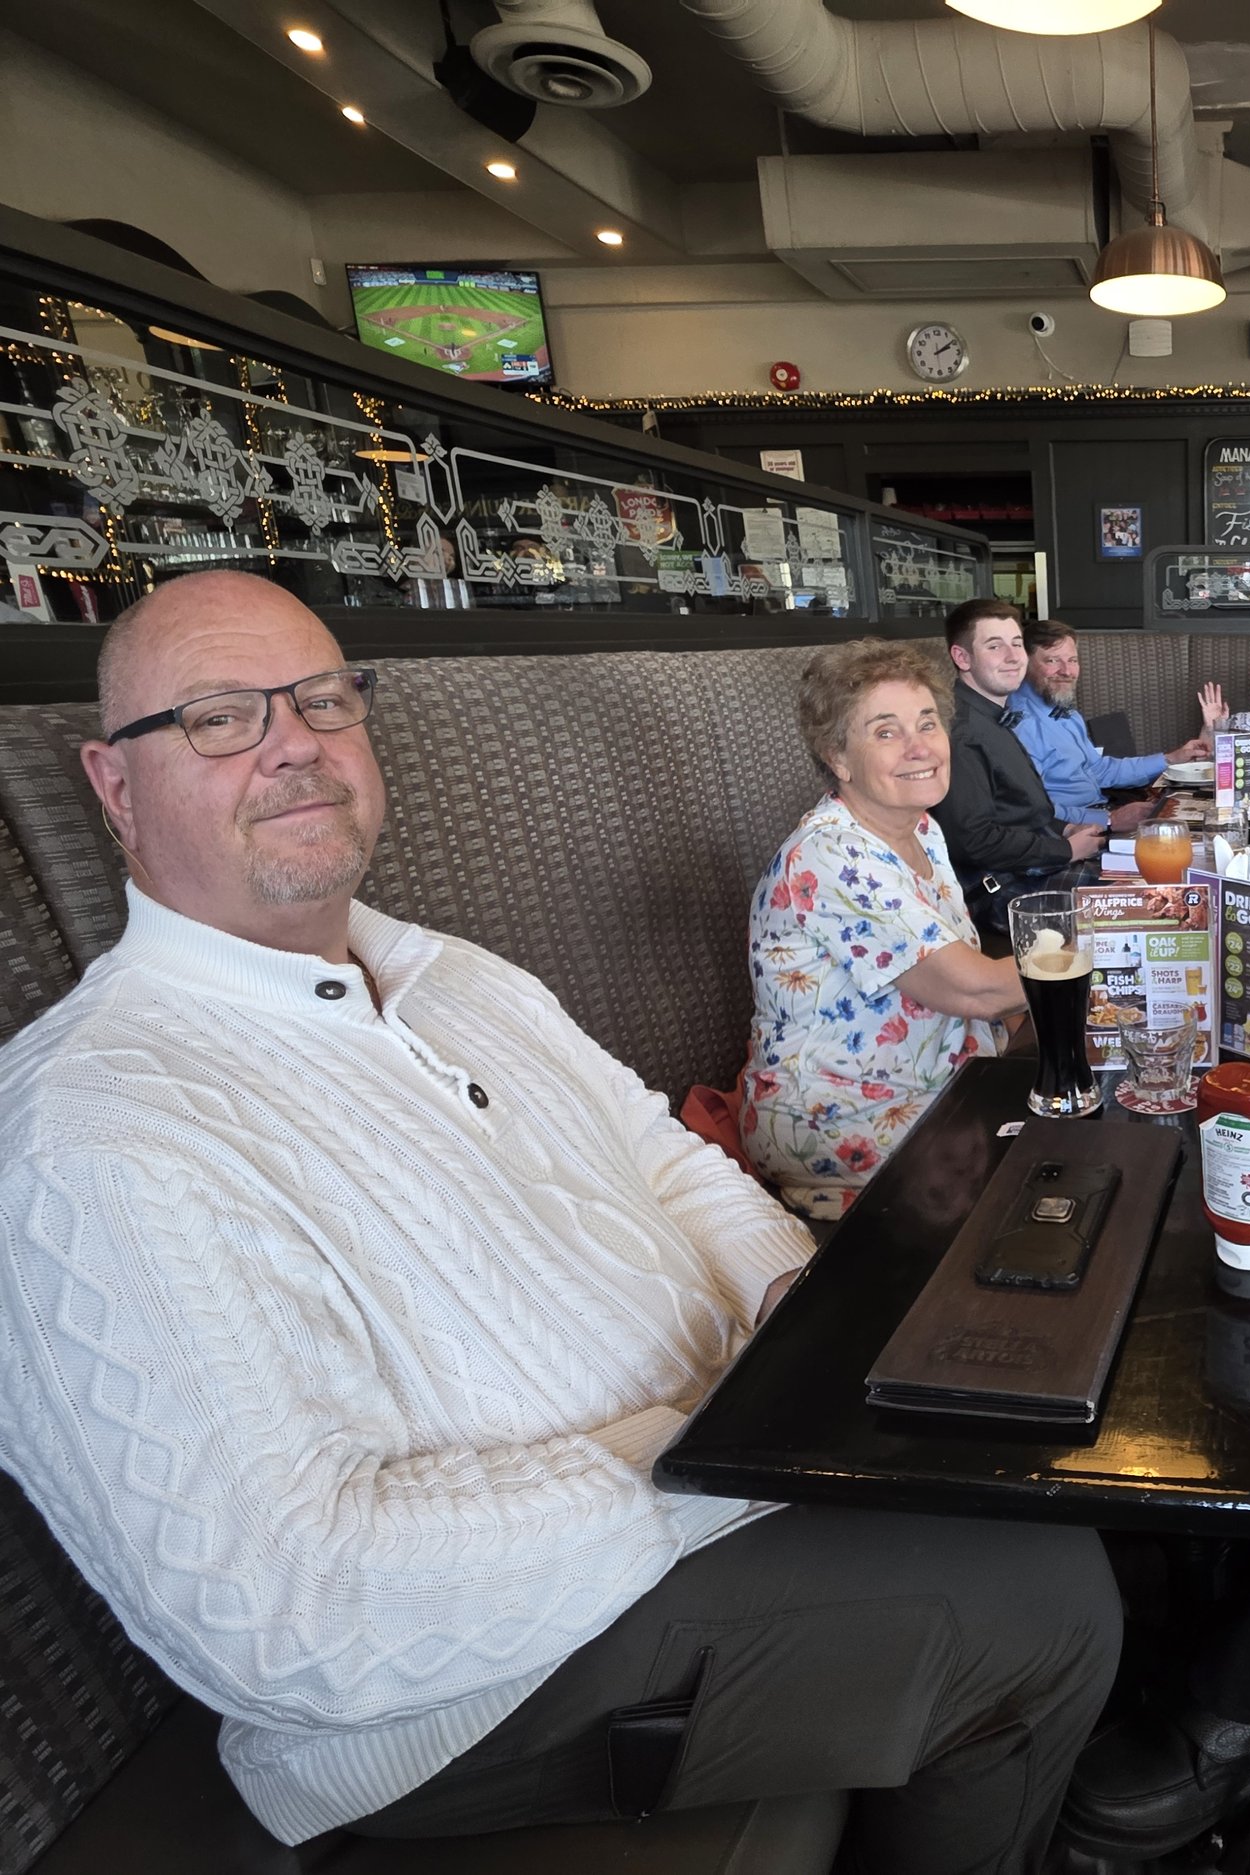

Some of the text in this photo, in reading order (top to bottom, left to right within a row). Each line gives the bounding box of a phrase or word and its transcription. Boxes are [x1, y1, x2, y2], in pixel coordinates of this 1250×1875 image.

[1188, 894, 1198, 904] R
[1149, 937, 1177, 947] OAK
[1159, 946, 1180, 957] UP!
[1107, 974, 1134, 985] FISH
[1107, 985, 1144, 996] CHIPS
[1215, 1128, 1244, 1142] HEINZ
